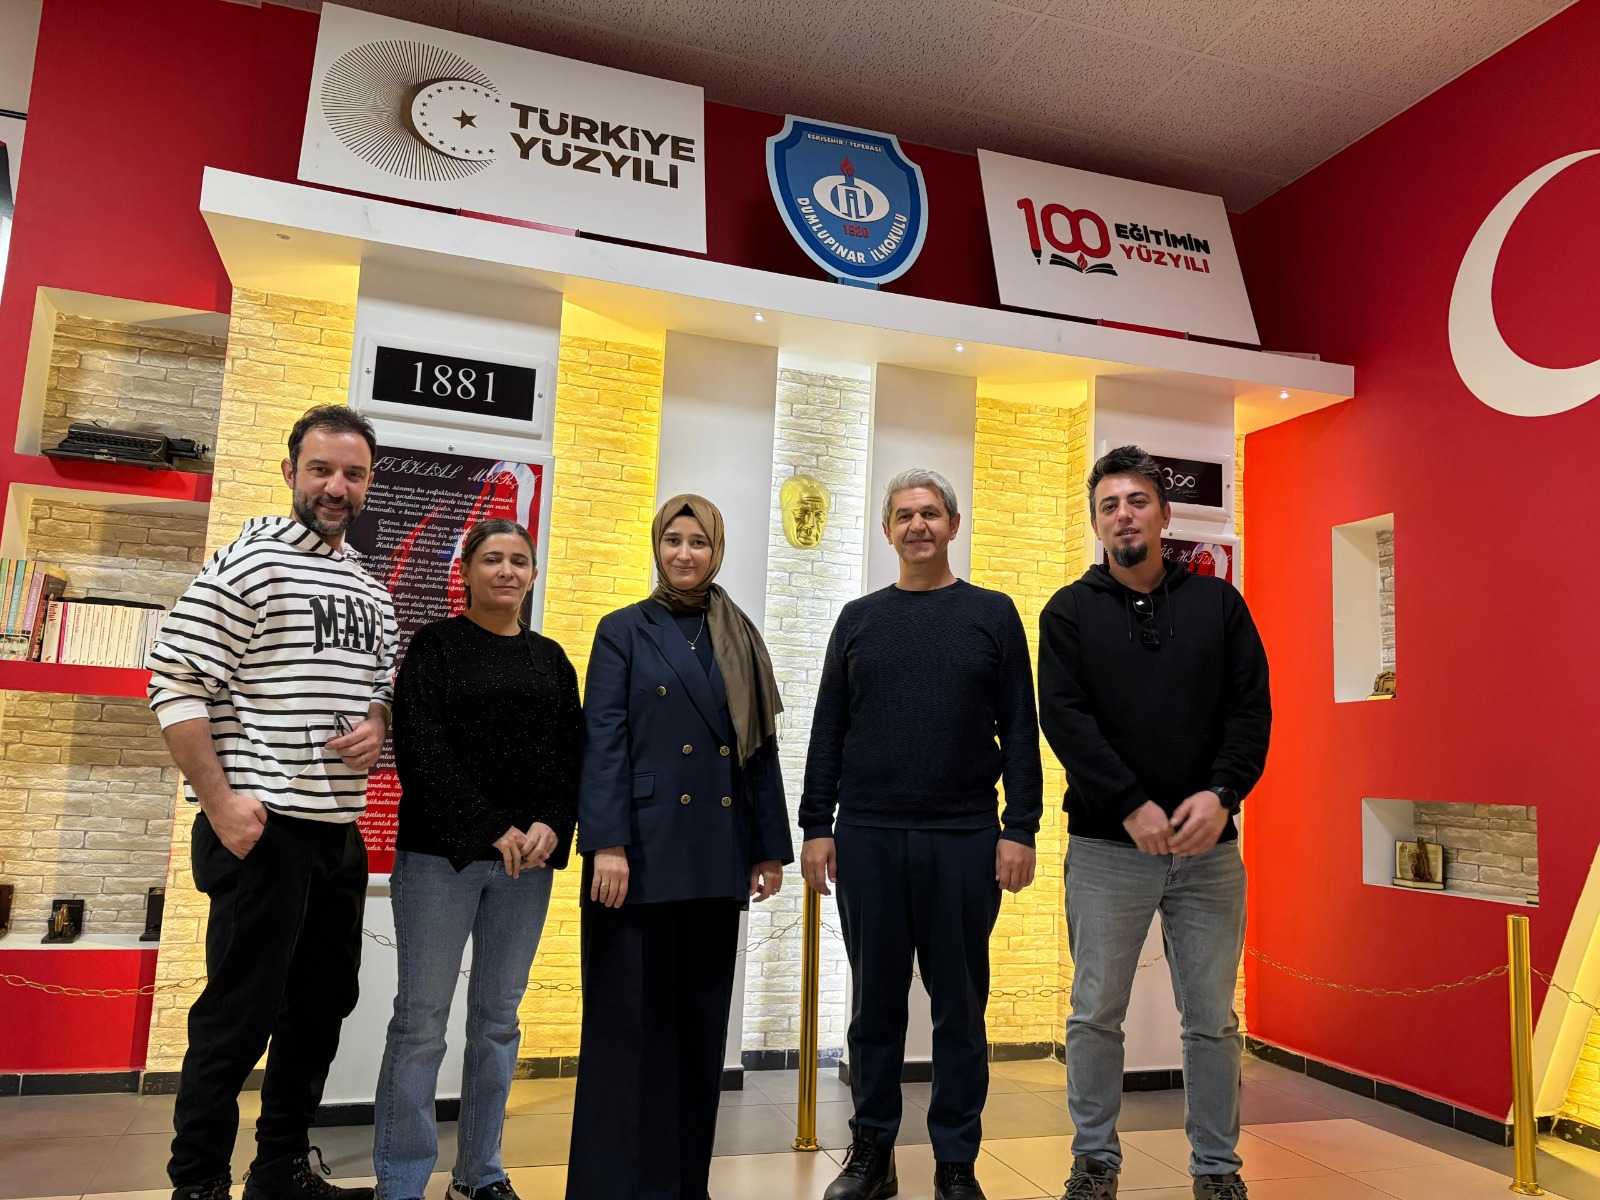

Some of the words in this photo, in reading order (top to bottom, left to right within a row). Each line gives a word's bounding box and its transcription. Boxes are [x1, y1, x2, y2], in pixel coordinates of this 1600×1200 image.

[510, 101, 696, 163] TÜRKİYE
[509, 132, 679, 189] YÜZYILI
[797, 197, 866, 264] DUMLUPINAR
[868, 213, 908, 262] İLKOKULU
[843, 224, 869, 238] 1920
[1017, 197, 1111, 260] 100
[1114, 222, 1211, 254] EĞİTİMİN
[1119, 243, 1210, 273] YÜZYILI
[411, 361, 496, 403] 1881
[372, 457, 463, 478] STİKLAL
[49, 603, 59, 623] Nutuk
[309, 594, 381, 656] MAV
